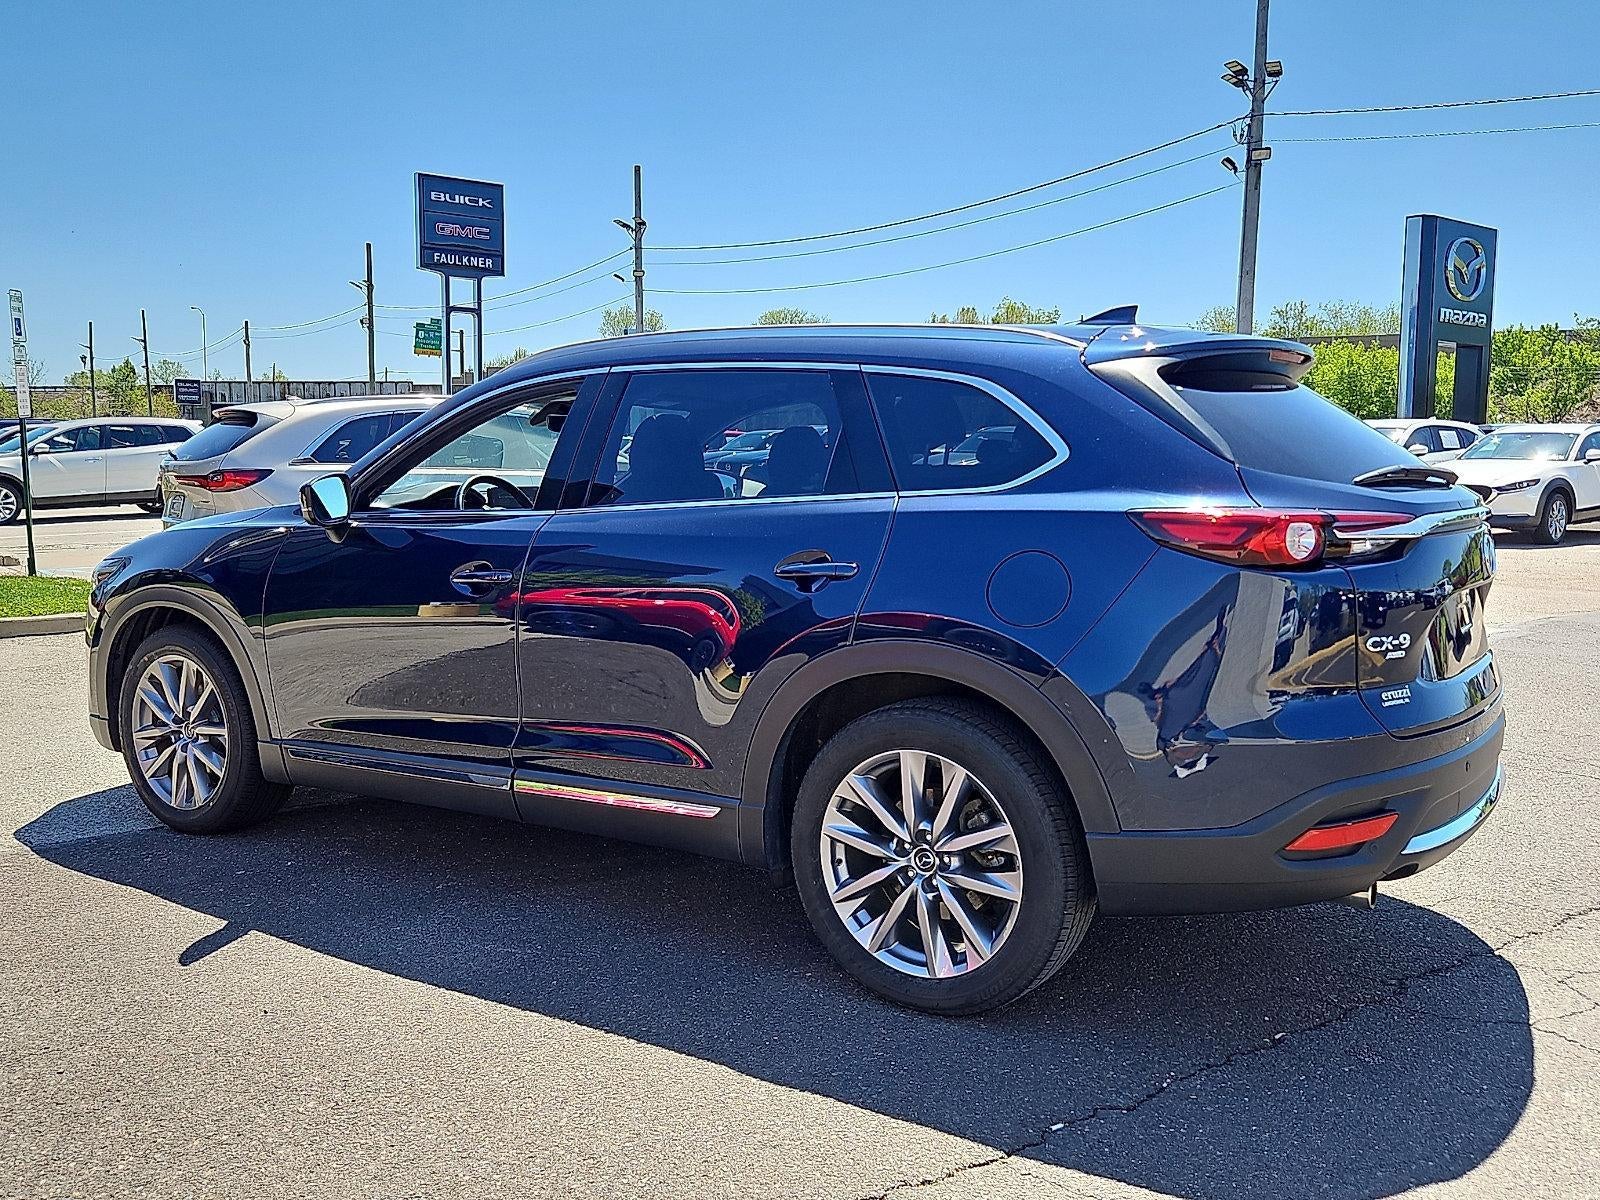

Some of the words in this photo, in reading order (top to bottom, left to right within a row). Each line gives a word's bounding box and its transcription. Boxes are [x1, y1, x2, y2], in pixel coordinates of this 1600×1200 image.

[430, 192, 493, 208] BUICK
[436, 222, 490, 240] GMC
[434, 252, 493, 268] FAULKNER
[1440, 308, 1487, 328] mazda
[1366, 633, 1411, 652] CX-9
